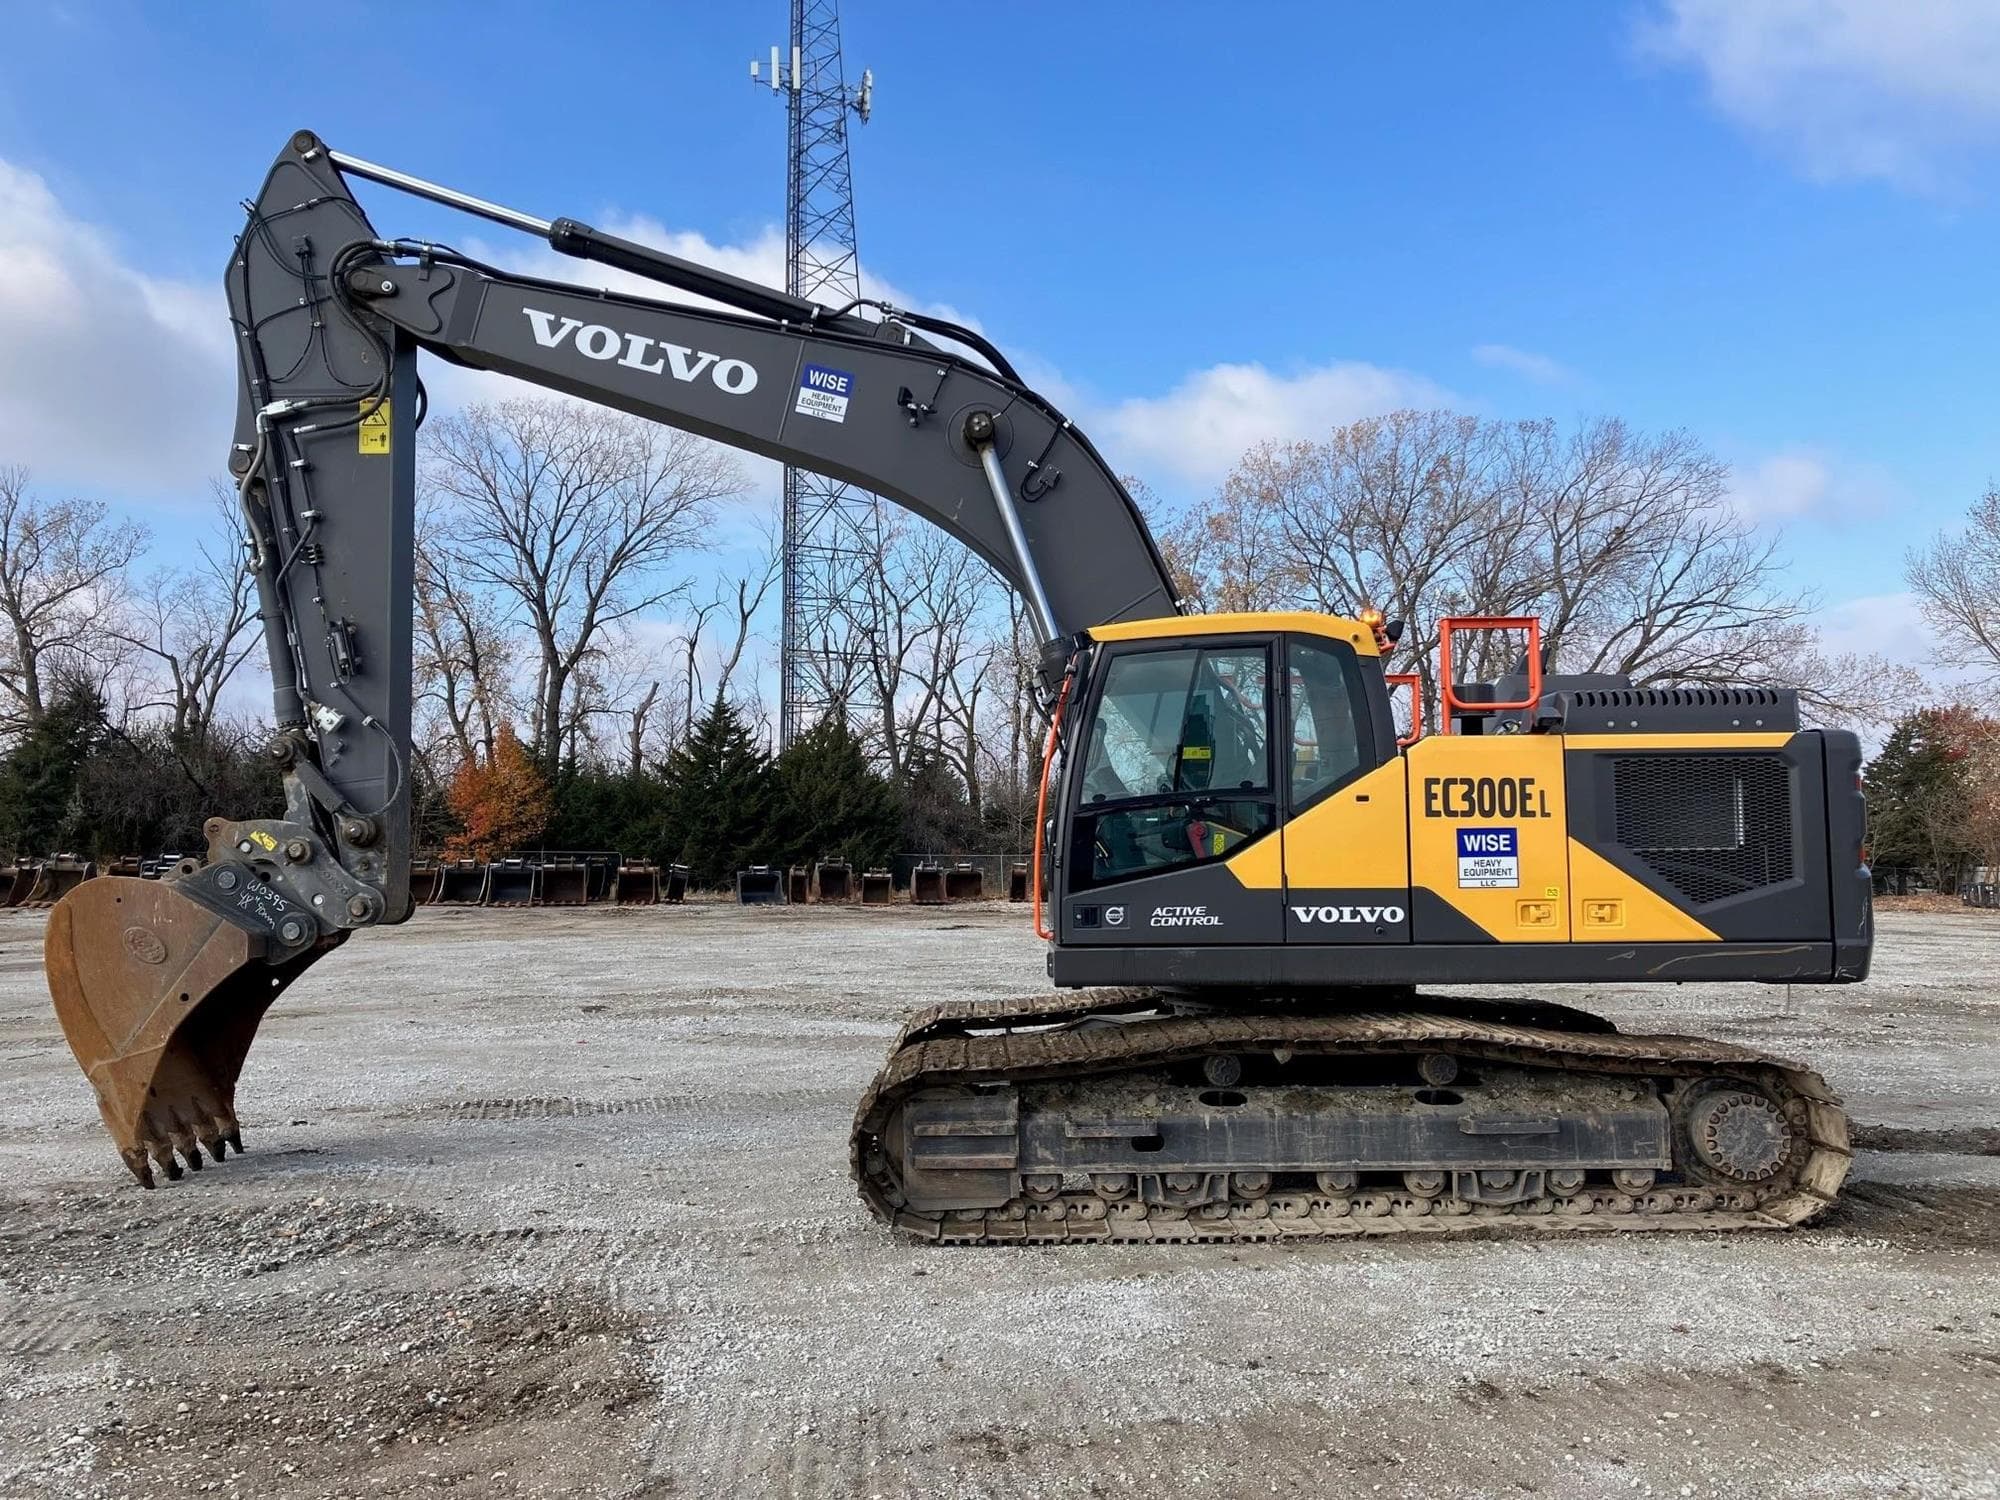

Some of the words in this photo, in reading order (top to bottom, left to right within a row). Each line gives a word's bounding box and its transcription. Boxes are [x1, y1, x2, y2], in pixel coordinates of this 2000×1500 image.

[522, 307, 758, 395] VOLVO
[809, 369, 849, 392] WISE
[811, 392, 835, 403] HEAVY
[801, 397, 842, 413] EQUIPMENT
[812, 410, 827, 418] LLC
[1463, 834, 1512, 852] WISE
[1473, 859, 1502, 868] HEAVY
[1463, 868, 1513, 877] EQUIPMENT
[1152, 906, 1207, 917] ACTIVE
[1290, 906, 1405, 923] VOLVO
[1150, 916, 1224, 927] CONTROL
